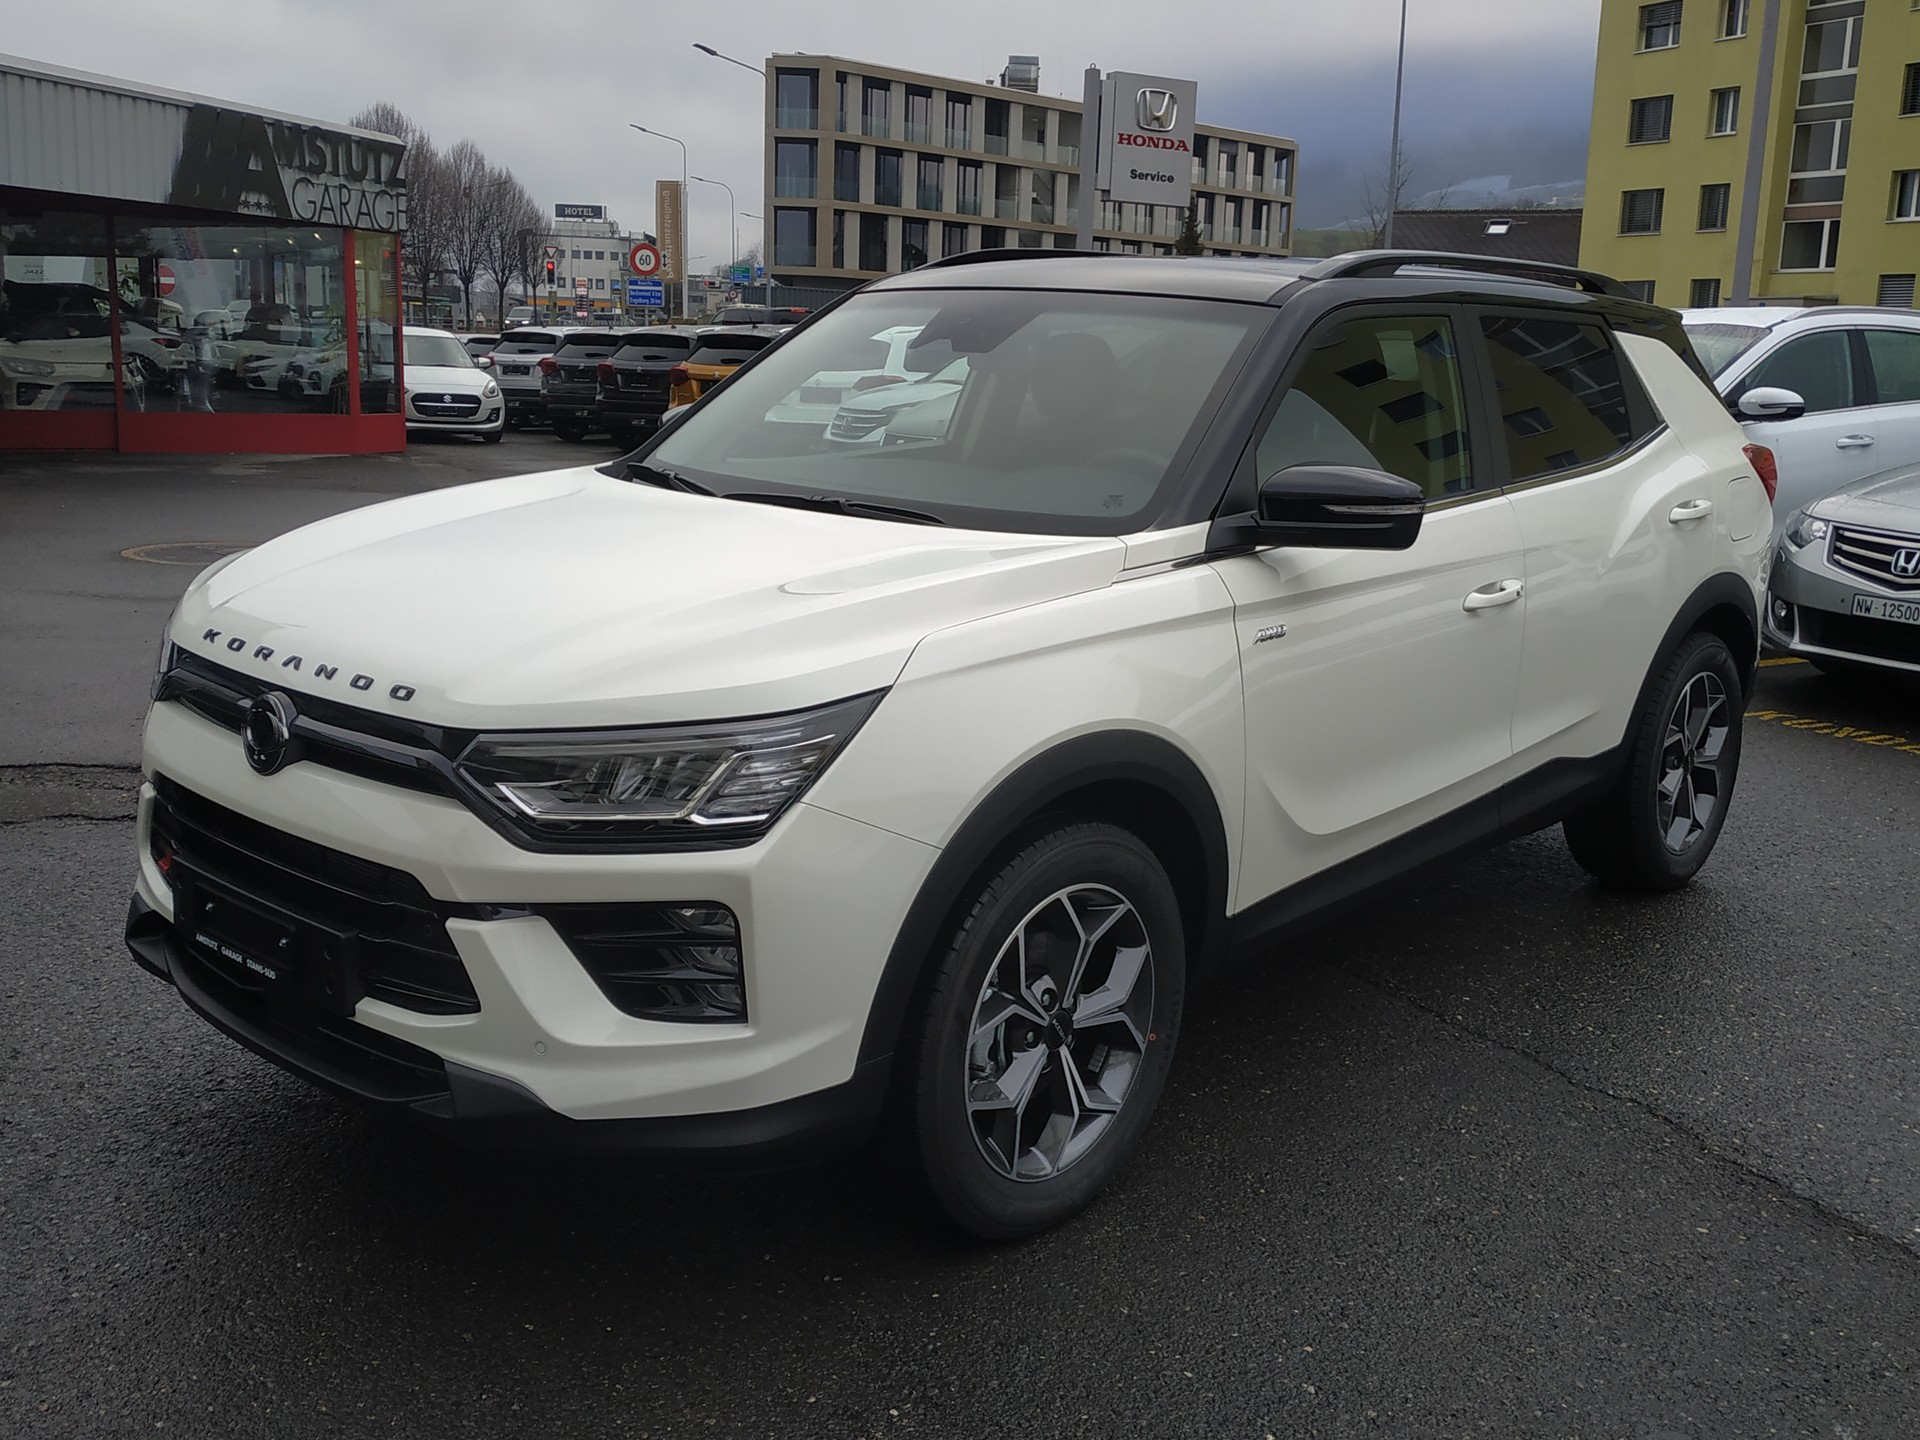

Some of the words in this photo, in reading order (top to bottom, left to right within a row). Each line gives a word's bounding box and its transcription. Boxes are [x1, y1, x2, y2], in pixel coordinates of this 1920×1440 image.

[1117, 133, 1190, 152] HONDA
[215, 110, 407, 218] AMSTUTZ
[1130, 169, 1175, 183] Service
[292, 177, 407, 231] GARAGE
[564, 207, 594, 216] HOTEL
[639, 254, 651, 266] 60
[1855, 598, 1873, 615] NW
[202, 628, 416, 702] KORANDO
[195, 932, 218, 951] AMSTUTZ
[221, 946, 243, 964] GARAGE
